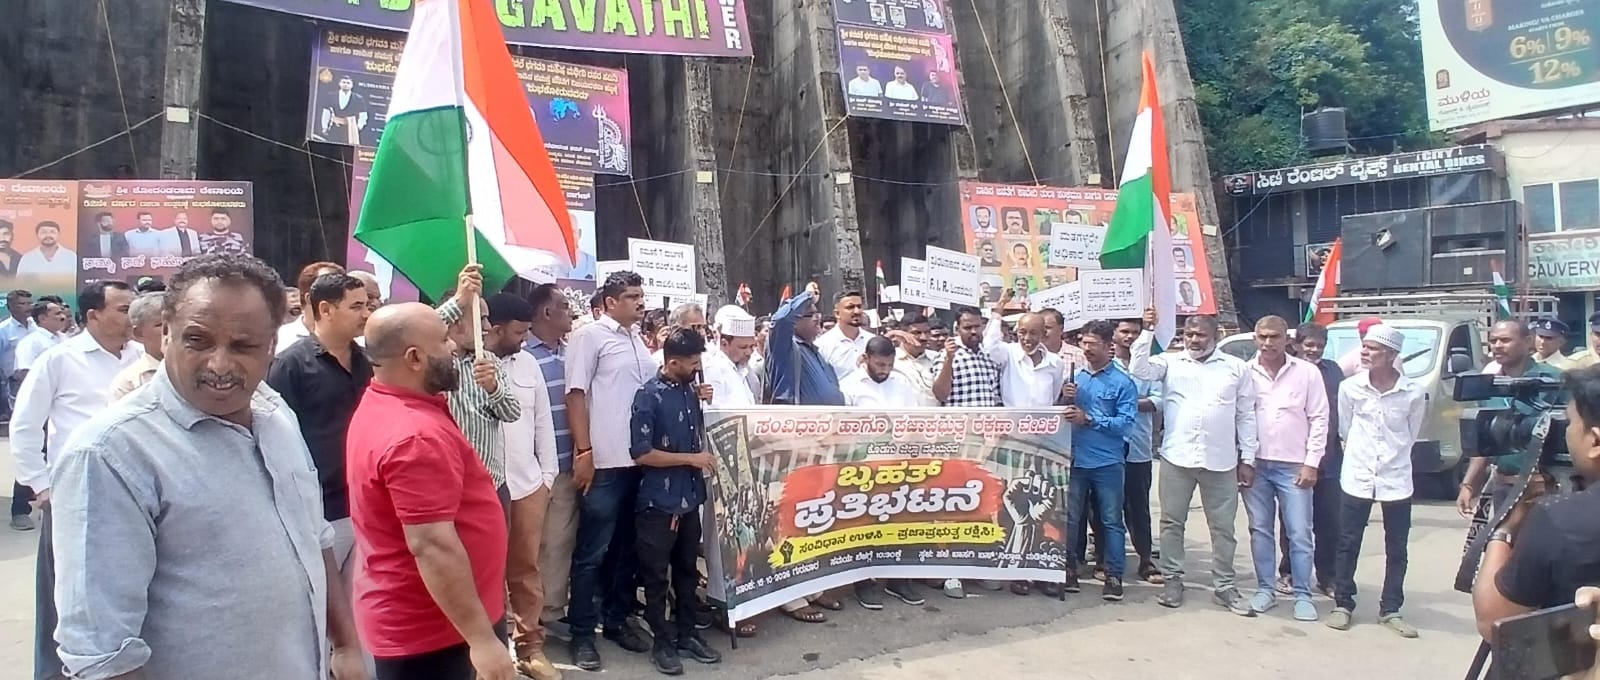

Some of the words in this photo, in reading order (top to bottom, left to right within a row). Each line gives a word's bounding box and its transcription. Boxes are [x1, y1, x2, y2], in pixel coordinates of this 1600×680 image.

[1510, 36, 1545, 59] 6%
[1554, 26, 1591, 50] 9%
[1528, 58, 1581, 84] 12%
[1438, 88, 1490, 107] ಮುಳಿಯ
[1393, 160, 1442, 174] RENTAL
[1444, 154, 1485, 168] BIKES
[1257, 170, 1283, 189] ಸಿಟಿ
[1528, 260, 1600, 279] CAUVERY
[754, 414, 832, 437] ಸಂವಿಧಾನ
[837, 415, 888, 435] ಹಾಗೂ
[892, 414, 968, 442] ಪ್ರಜಾಪ್ರಭುತ್ವ
[972, 415, 1013, 441] ರಕ್ಷಣಾ
[838, 460, 943, 492] ಬೃಹತ್
[794, 480, 984, 535] ಪ್ರತಿಭಟನೆ
[799, 532, 847, 554] ಸಂವಿಧಾನ
[849, 530, 883, 543] ಉಳಿಸಿ
[897, 526, 960, 541] ಪ್ರಜಾಪ್ರಭುತ್ವ
[963, 526, 995, 540] ರಕ್ಷಿಸಿ!
